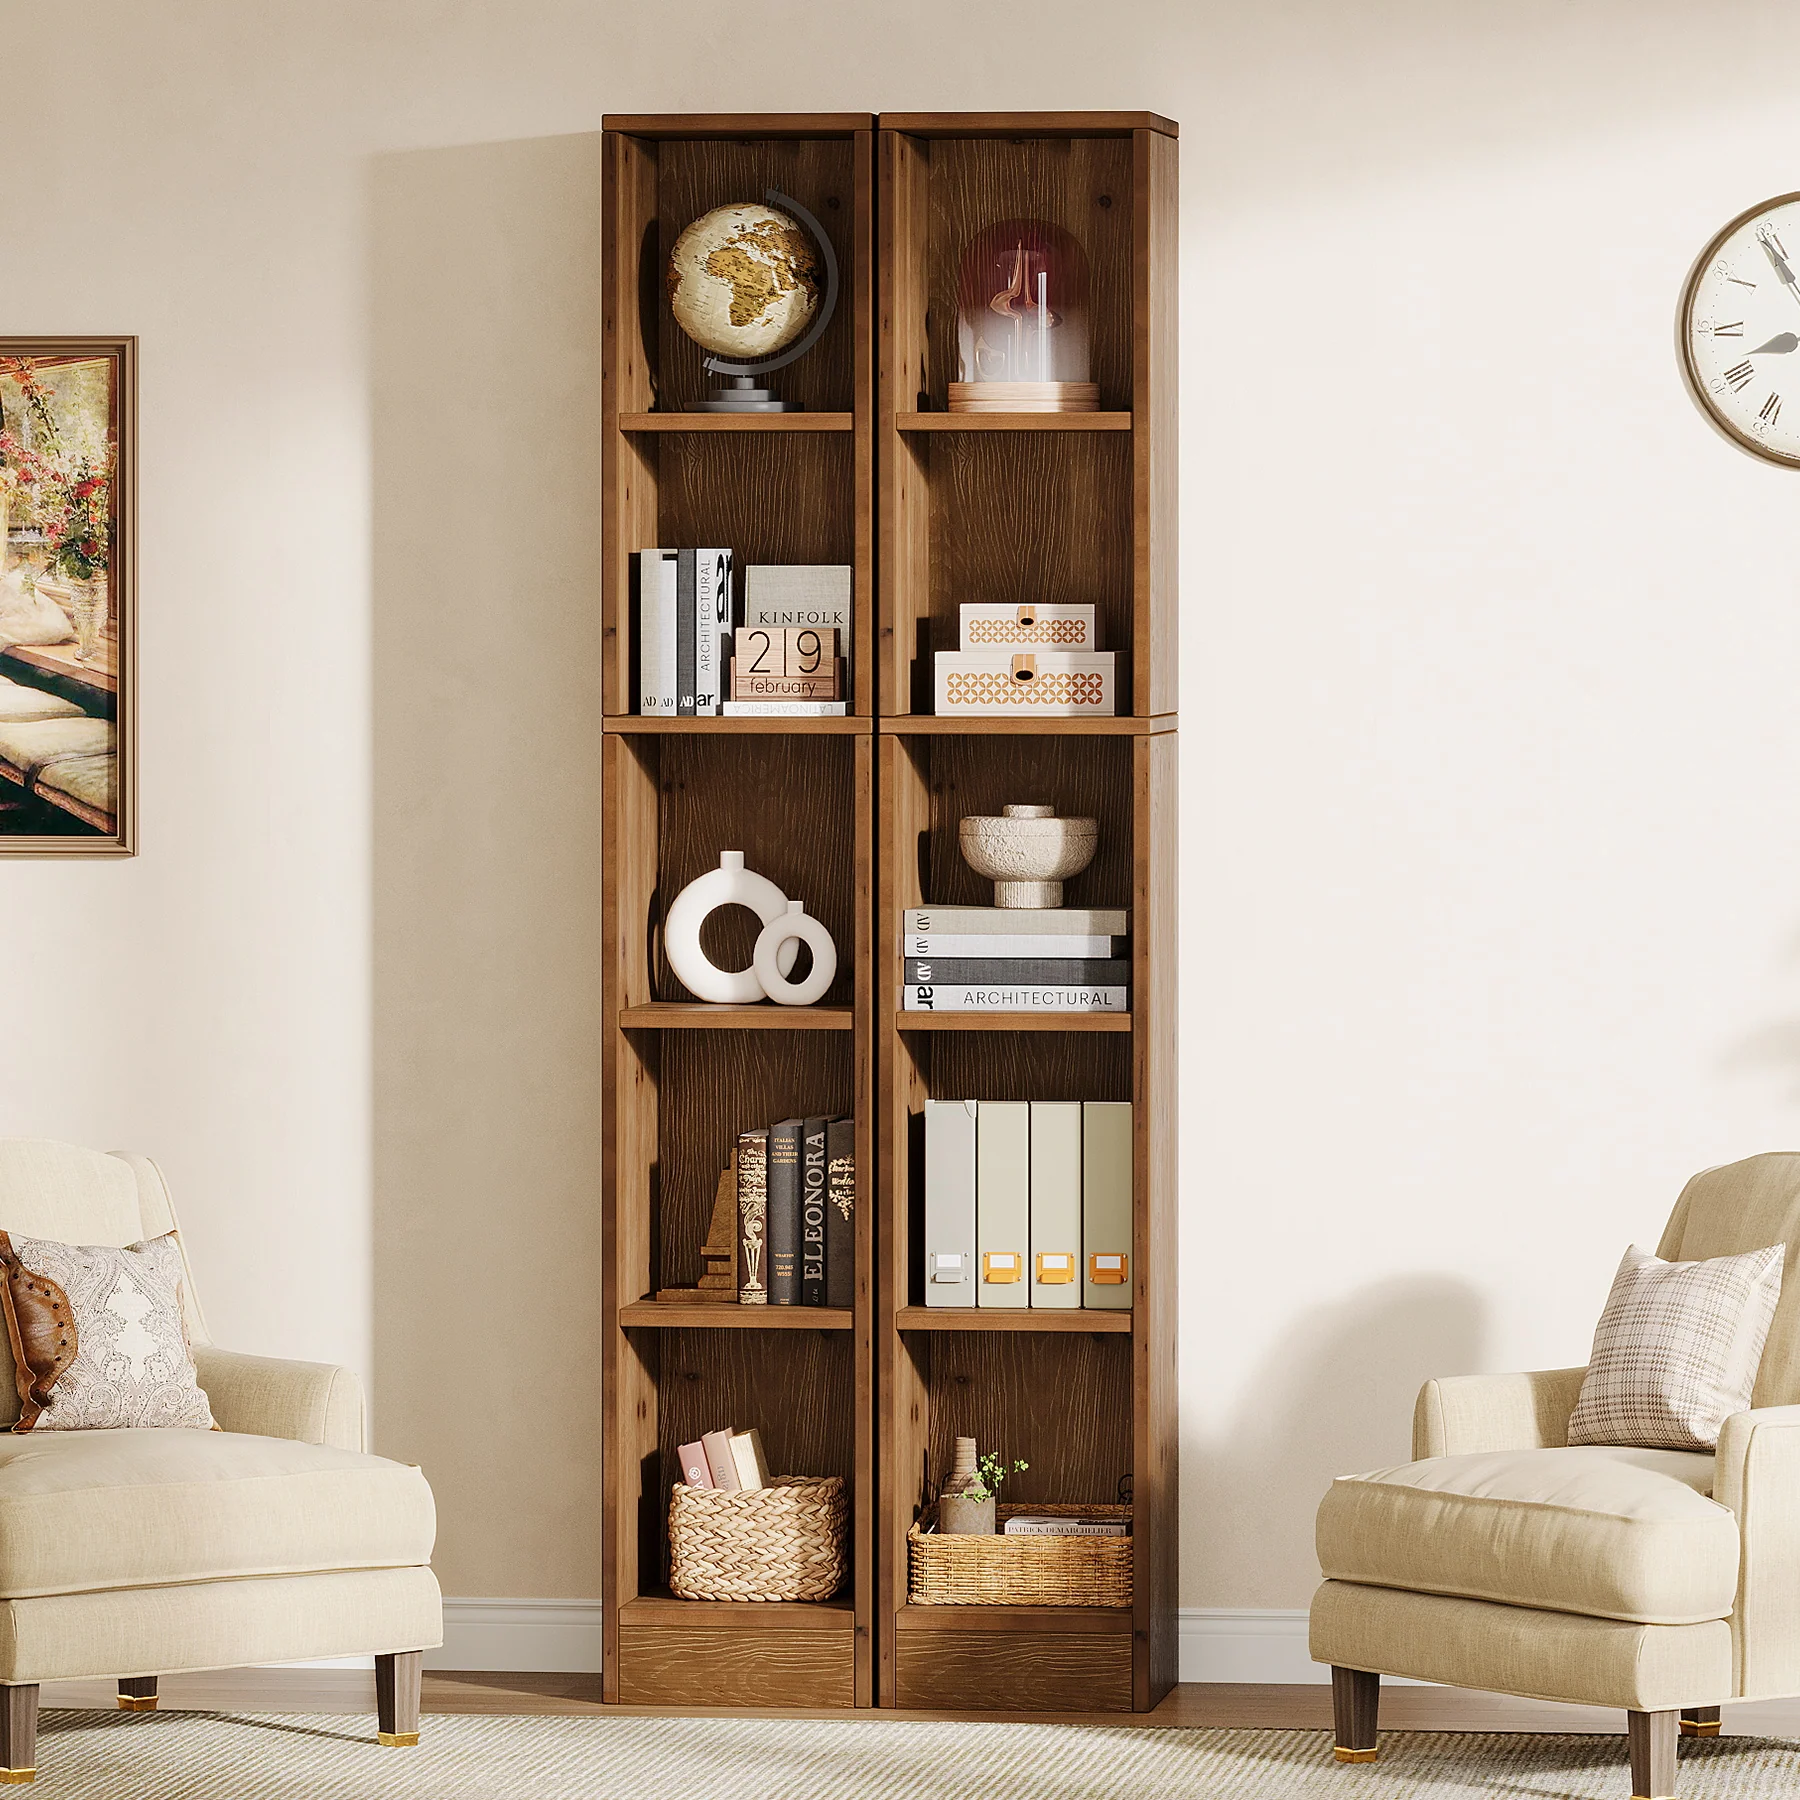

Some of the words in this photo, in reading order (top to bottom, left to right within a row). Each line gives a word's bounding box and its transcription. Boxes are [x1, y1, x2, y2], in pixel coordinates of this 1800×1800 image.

[700, 559, 711, 672] ARCHITECTURAL
[759, 611, 844, 624] KINFOLK
[750, 678, 816, 697] february
[643, 696, 657, 707] AD
[660, 698, 674, 708] AD
[680, 696, 694, 708] AD
[698, 693, 714, 706] ar
[734, 704, 834, 714] LATINOAMERICA
[916, 912, 930, 931] AD
[916, 937, 928, 954] AD
[916, 961, 932, 982] AD
[917, 986, 934, 1010] ar
[964, 992, 1112, 1005] ARCHITECTURAL
[804, 1132, 825, 1281] ELEONORA
